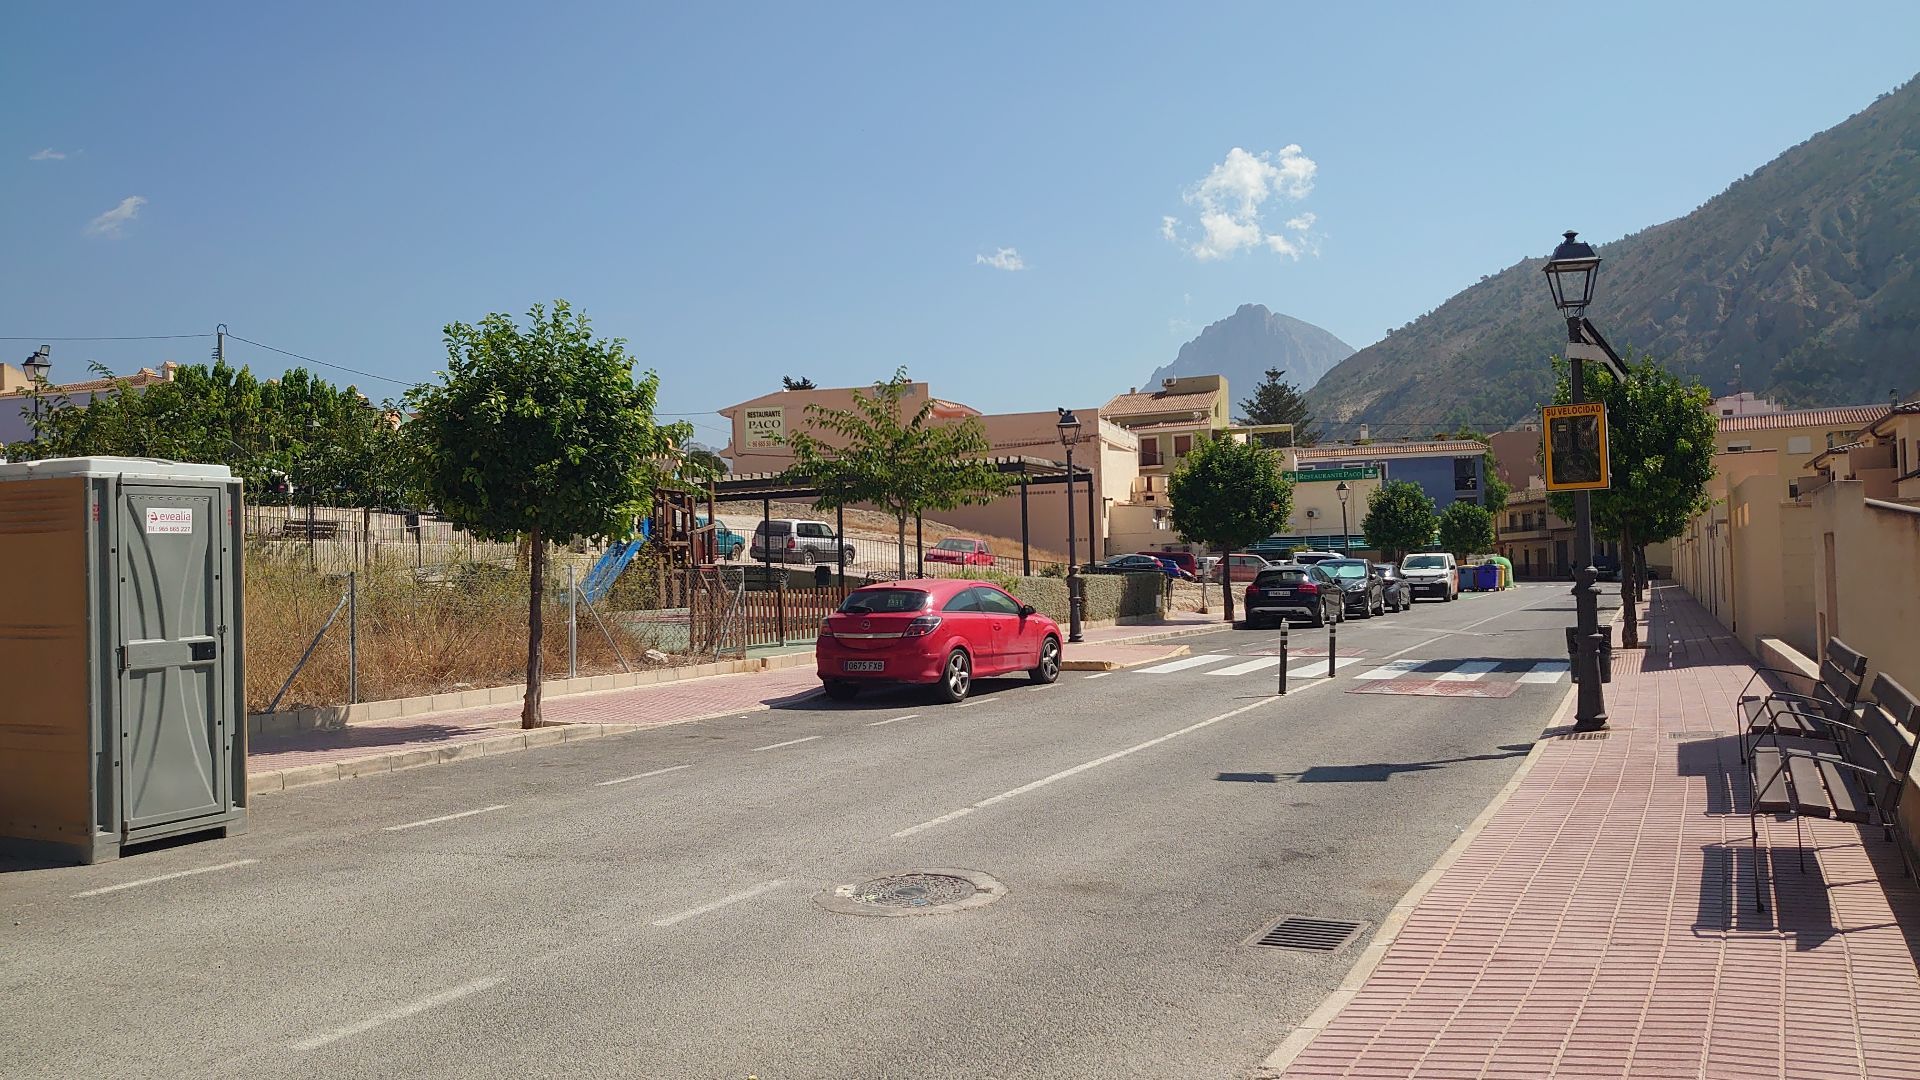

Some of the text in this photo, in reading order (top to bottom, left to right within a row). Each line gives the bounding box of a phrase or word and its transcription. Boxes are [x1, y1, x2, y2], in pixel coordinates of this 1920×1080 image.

[747, 410, 781, 418] RESTAURANTE
[1546, 405, 1601, 416] SU VELOCIDAD
[749, 419, 781, 429] PACO
[1299, 472, 1343, 480] RESTAURANTE
[160, 511, 191, 521] evealia
[848, 661, 883, 670] 0675 FXB
